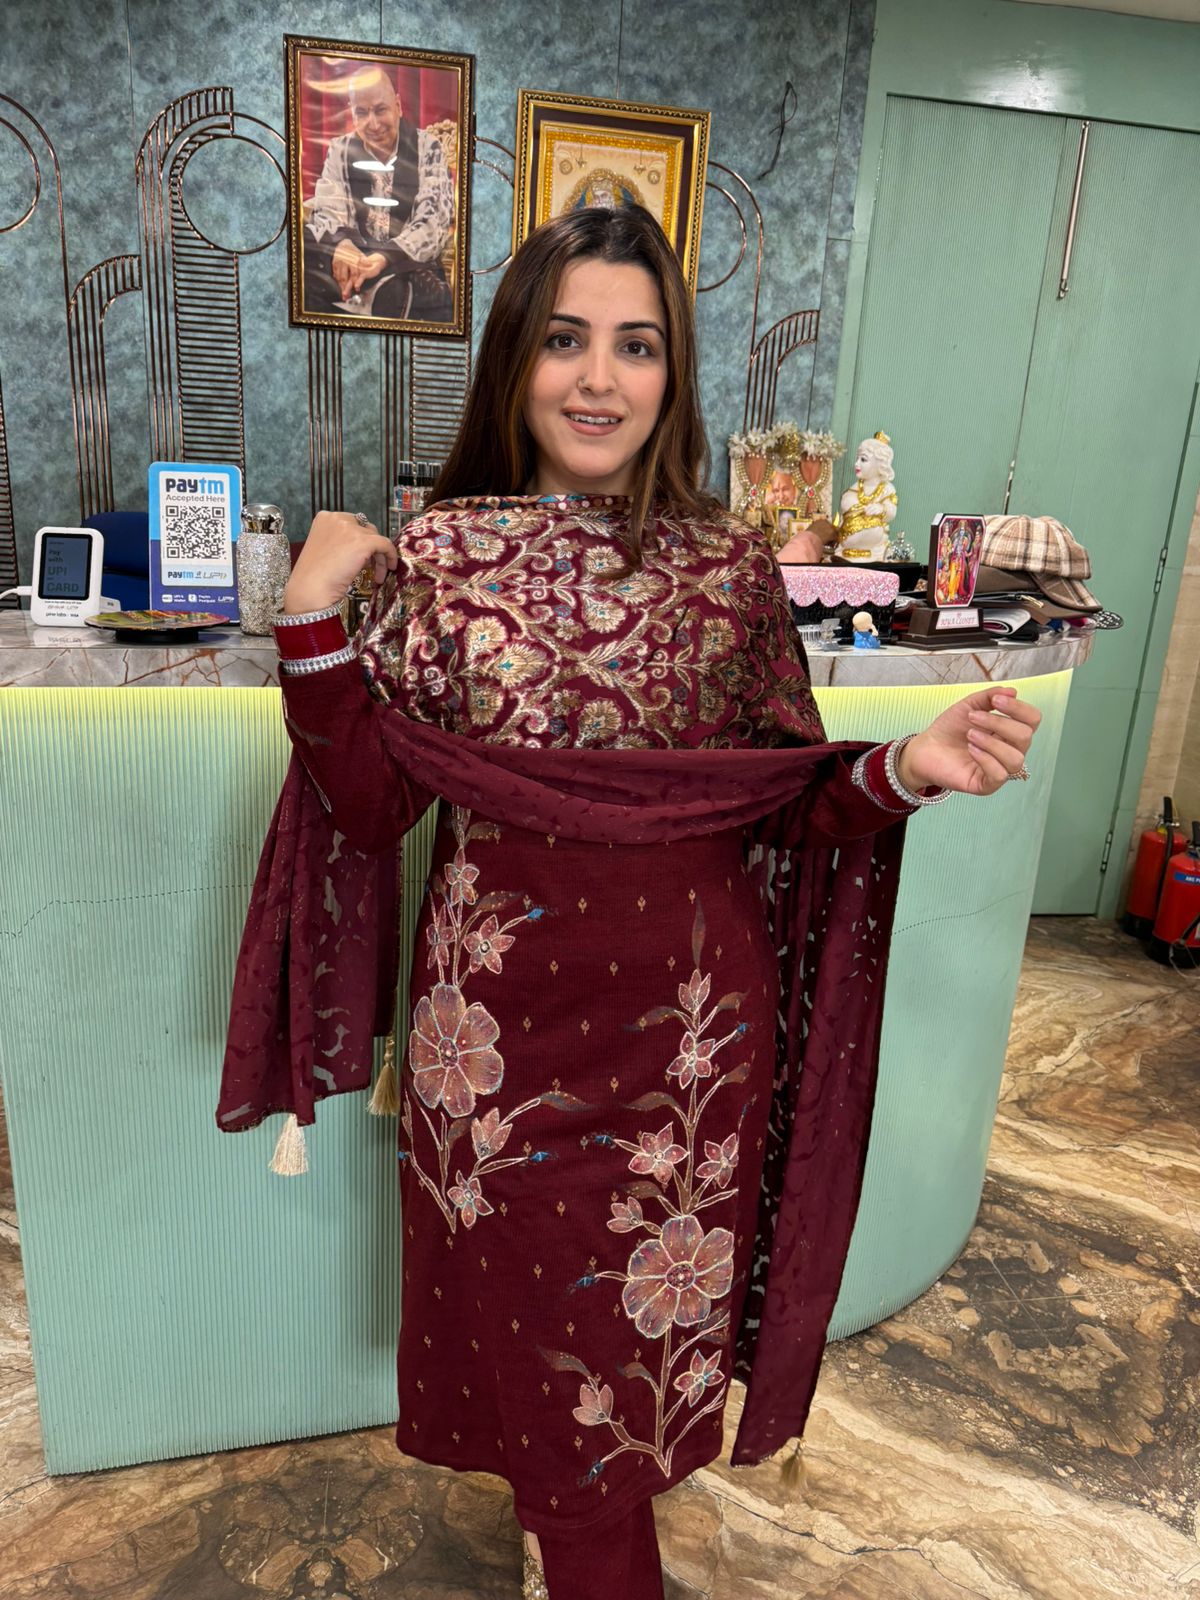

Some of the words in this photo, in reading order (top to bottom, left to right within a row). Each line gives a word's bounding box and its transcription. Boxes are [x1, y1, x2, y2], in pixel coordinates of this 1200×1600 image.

[166, 494, 204, 503] Accepted
[206, 495, 225, 503] Here
[47, 566, 68, 576] UPI
[47, 582, 79, 592] CARD
